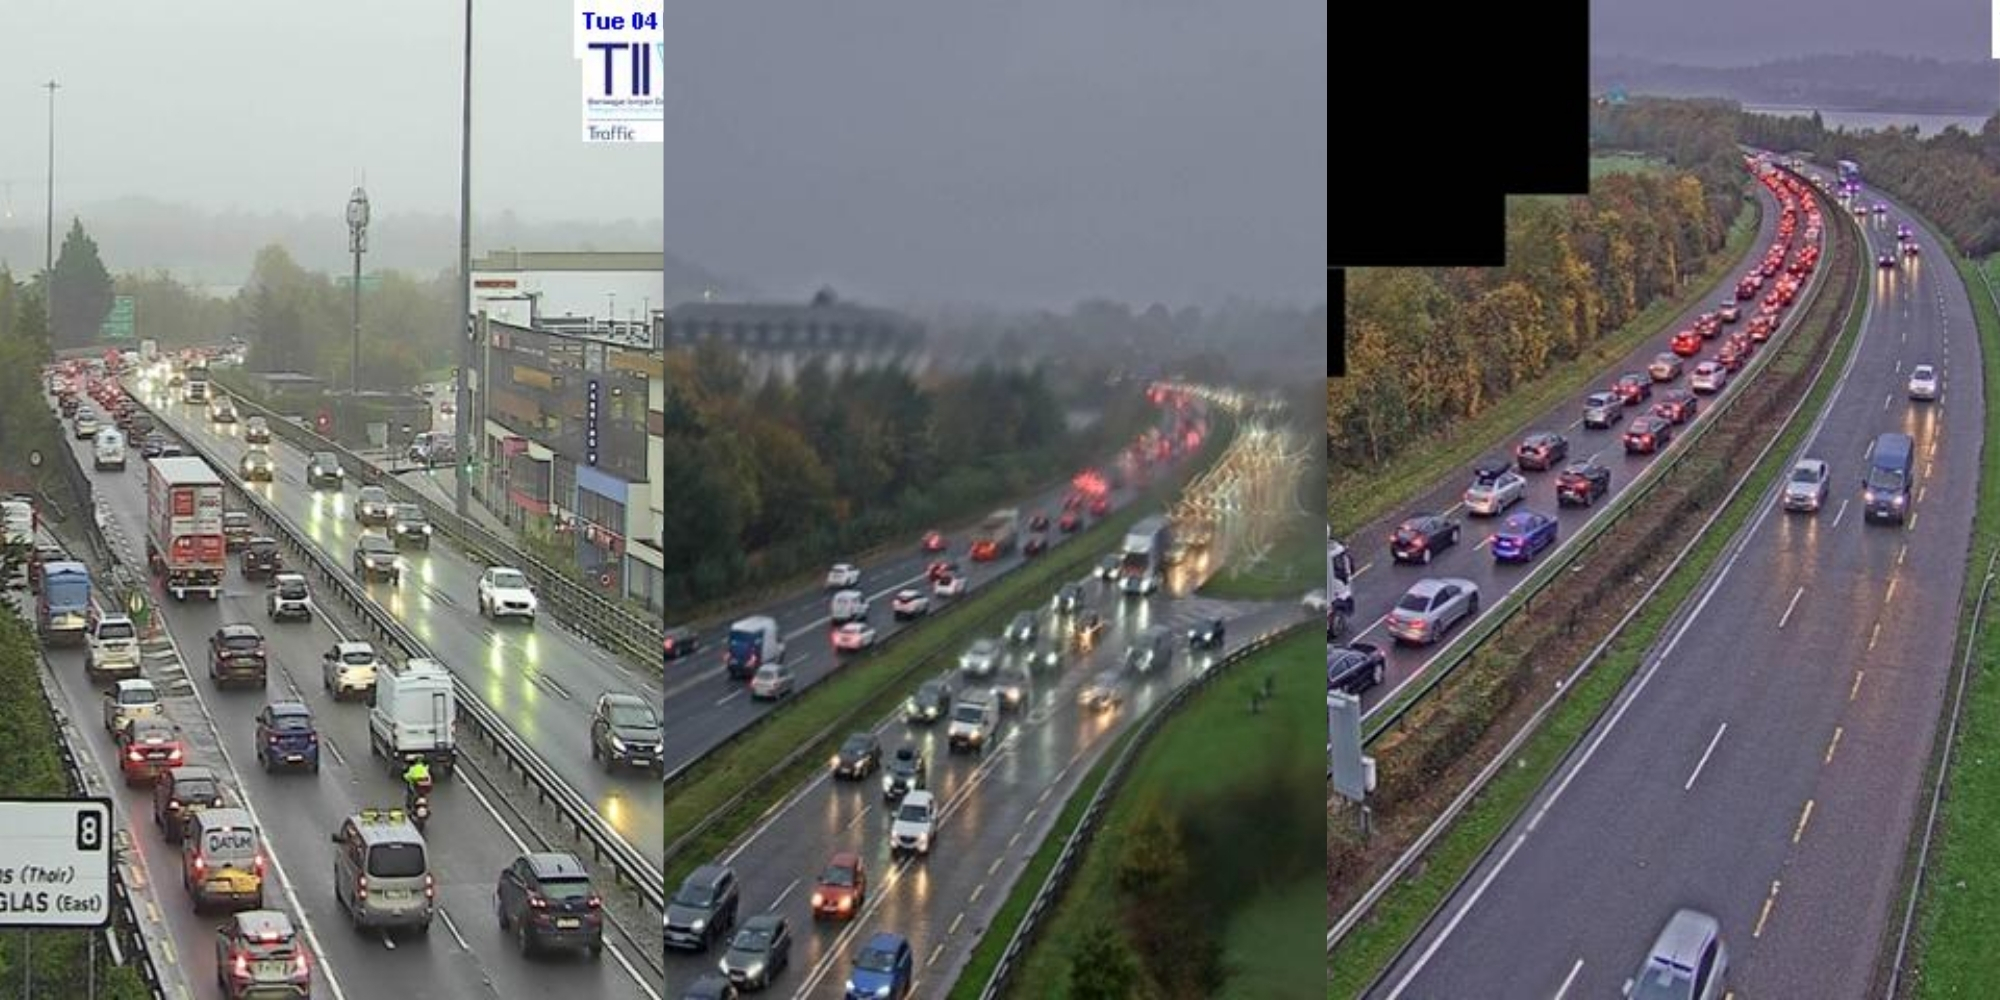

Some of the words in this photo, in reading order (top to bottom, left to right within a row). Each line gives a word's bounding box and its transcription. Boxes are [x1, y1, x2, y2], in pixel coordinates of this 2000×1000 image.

[82, 817, 97, 845] 8
[21, 866, 75, 884] (Thoir)
[56, 894, 102, 912] (East)
